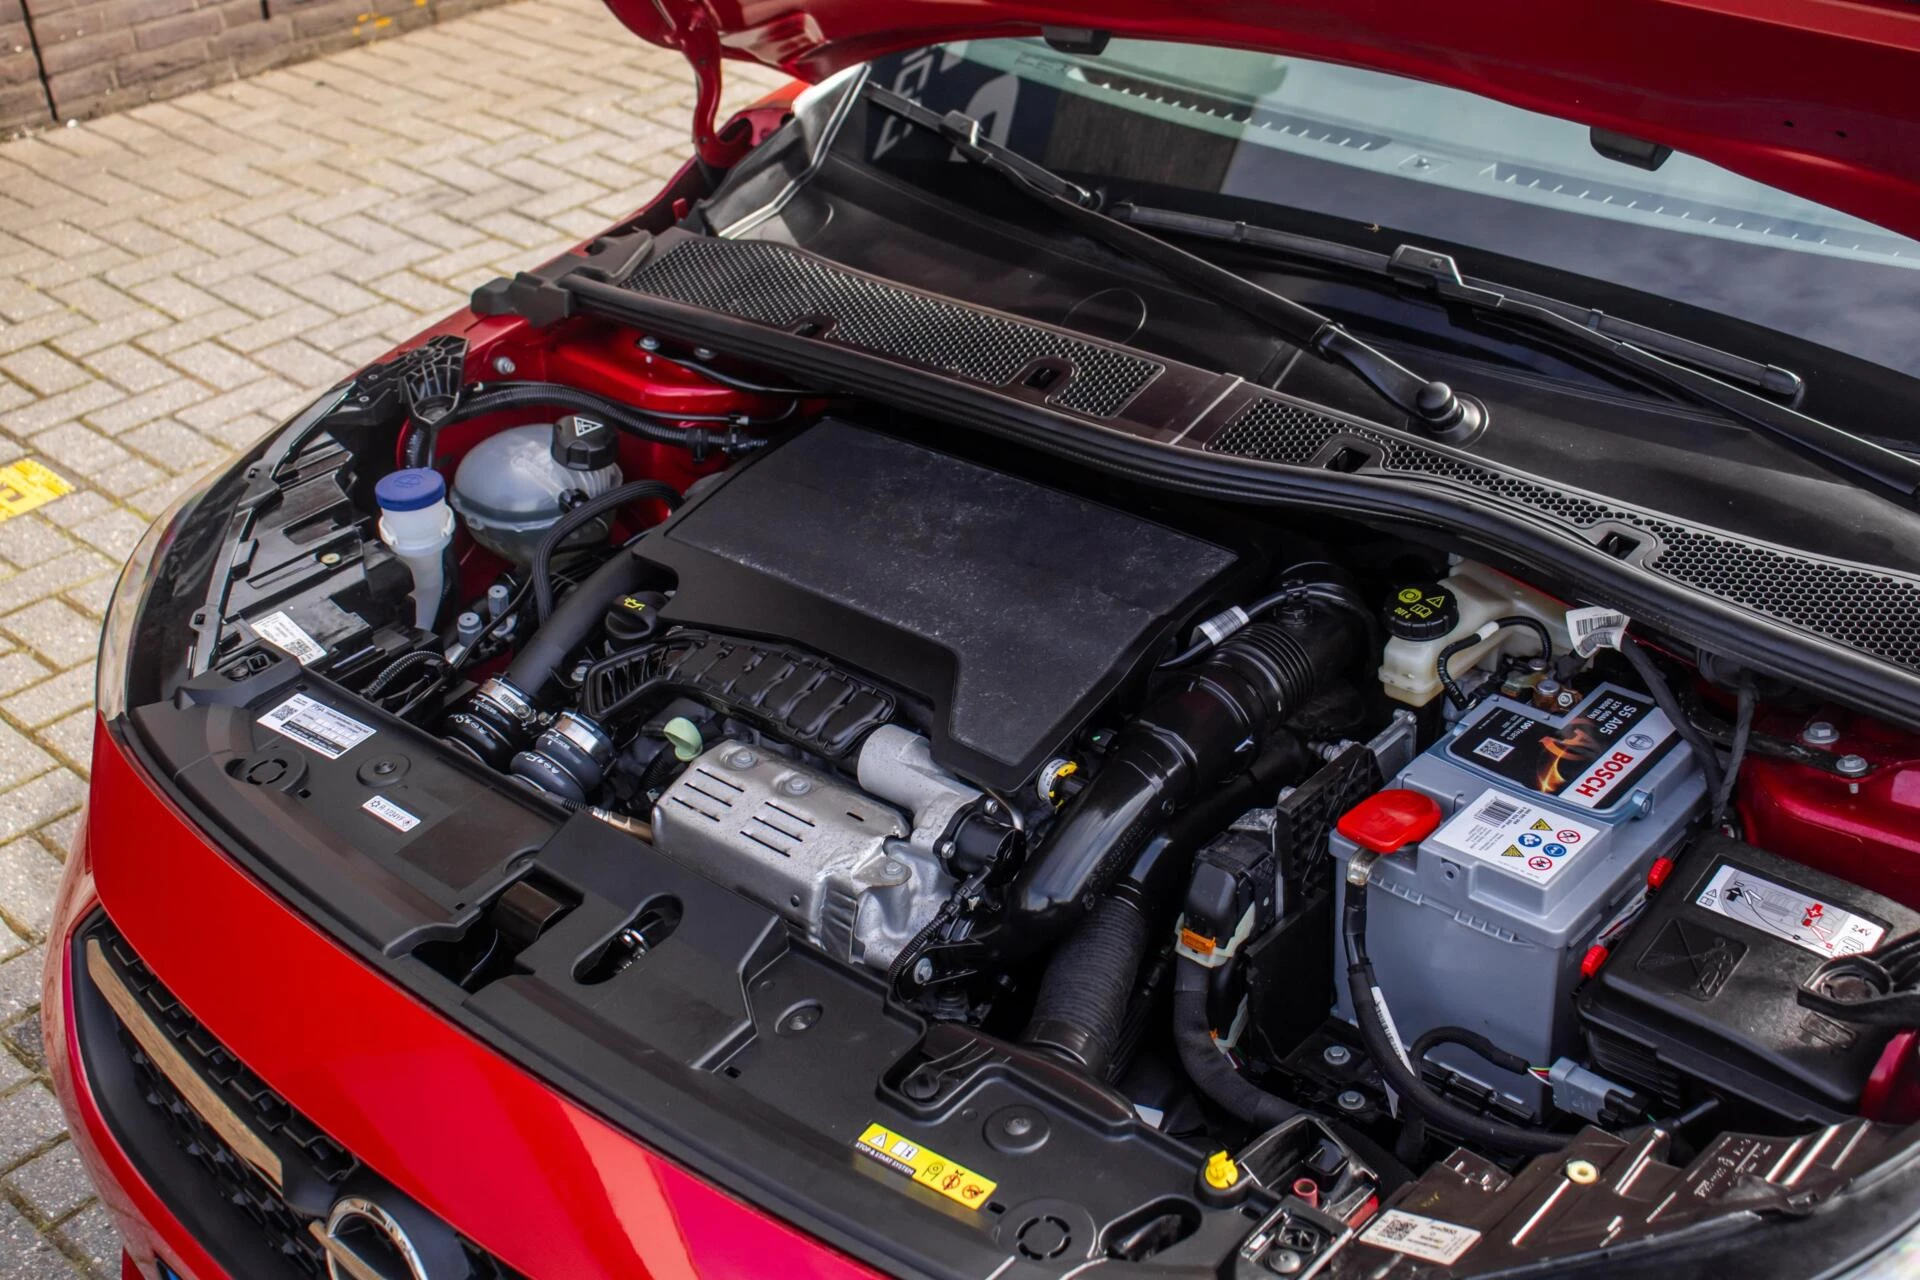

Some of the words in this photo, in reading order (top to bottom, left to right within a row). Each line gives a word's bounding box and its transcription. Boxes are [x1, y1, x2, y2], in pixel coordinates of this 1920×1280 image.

[1618, 704, 1637, 719] S5
[1520, 720, 1534, 730] 100
[1599, 716, 1623, 736] A05
[1575, 751, 1634, 798] BOSCH
[855, 1141, 871, 1153] STOP
[874, 1151, 893, 1164] START
[891, 1159, 915, 1176] SYSTEM
